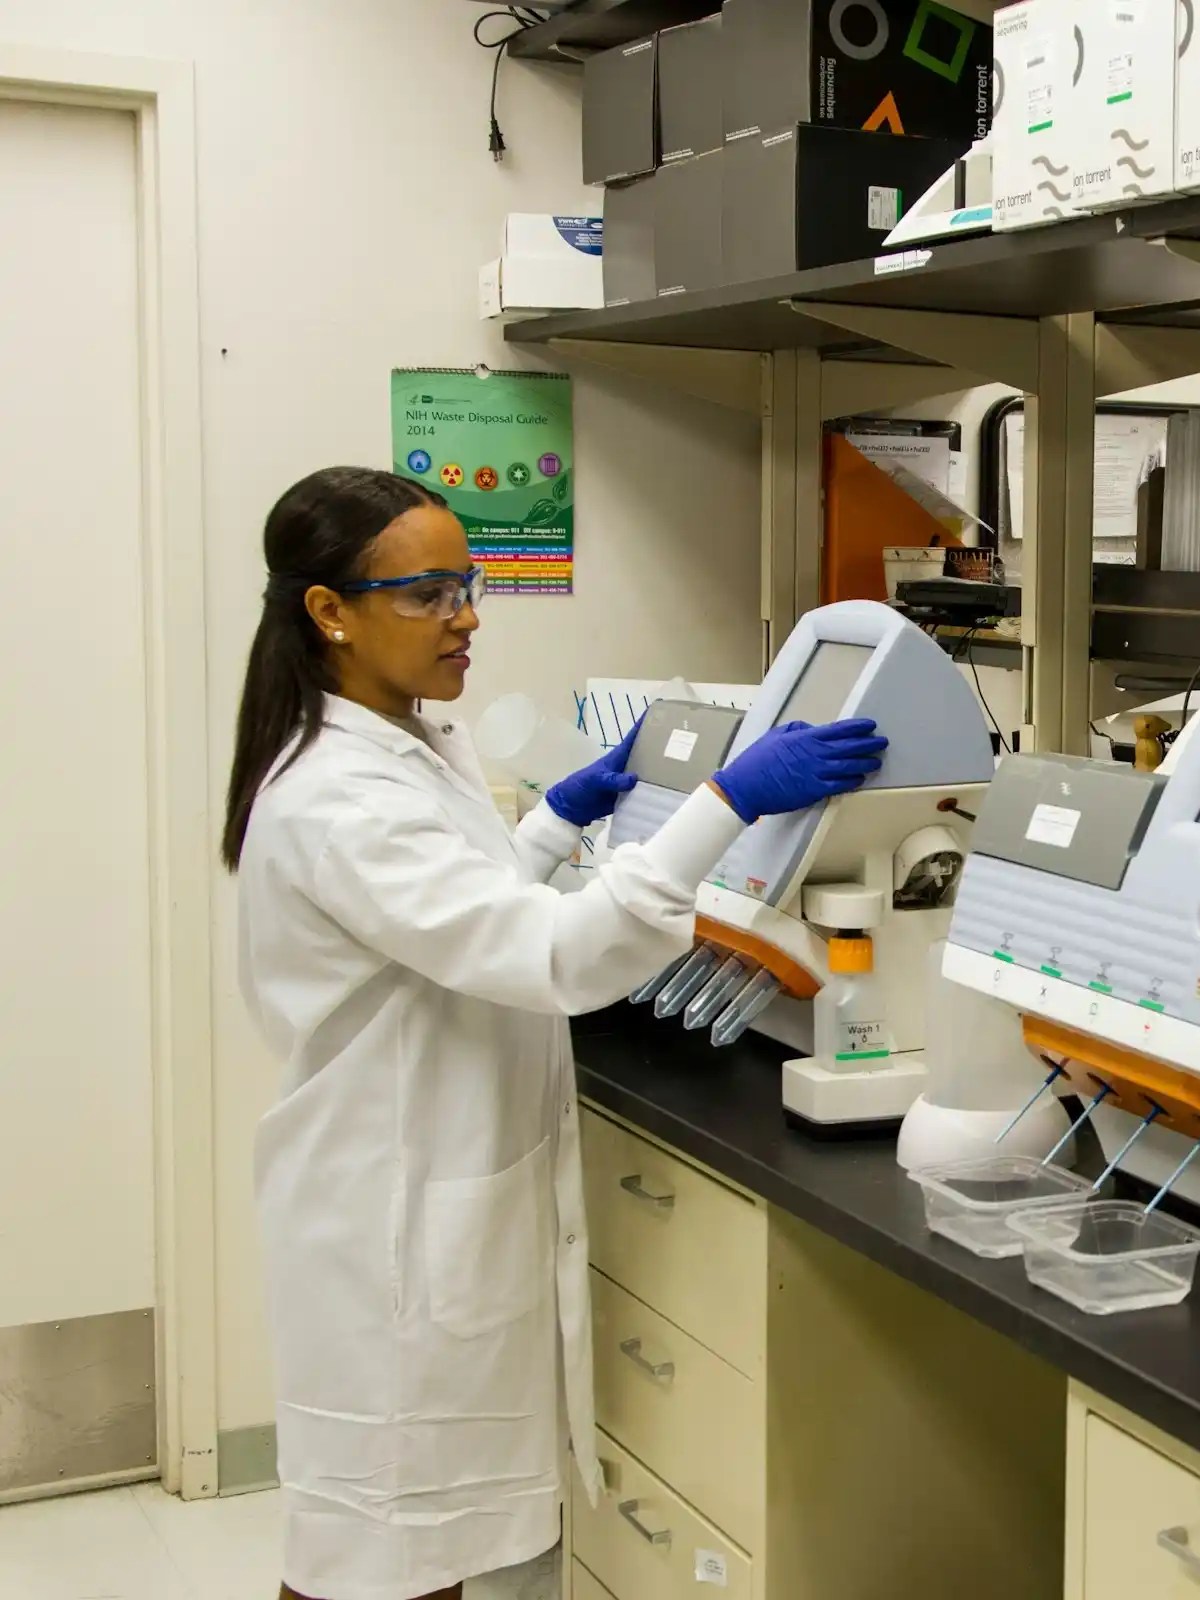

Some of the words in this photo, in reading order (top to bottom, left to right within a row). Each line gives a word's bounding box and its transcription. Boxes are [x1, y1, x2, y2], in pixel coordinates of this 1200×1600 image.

[827, 57, 837, 119] sequencing
[976, 64, 988, 114] torrent
[974, 118, 987, 139] ion
[1181, 149, 1193, 164] ion
[1073, 173, 1084, 188] ion
[1085, 167, 1111, 185] torrent
[1007, 191, 1032, 208] torrent
[406, 410, 427, 421] NIH
[431, 411, 464, 422] Waste
[468, 412, 514, 425] Disposal
[516, 413, 549, 425] Guide
[407, 425, 435, 436] 2014
[847, 1025, 873, 1035] Wash
[876, 1024, 880, 1032] 1
